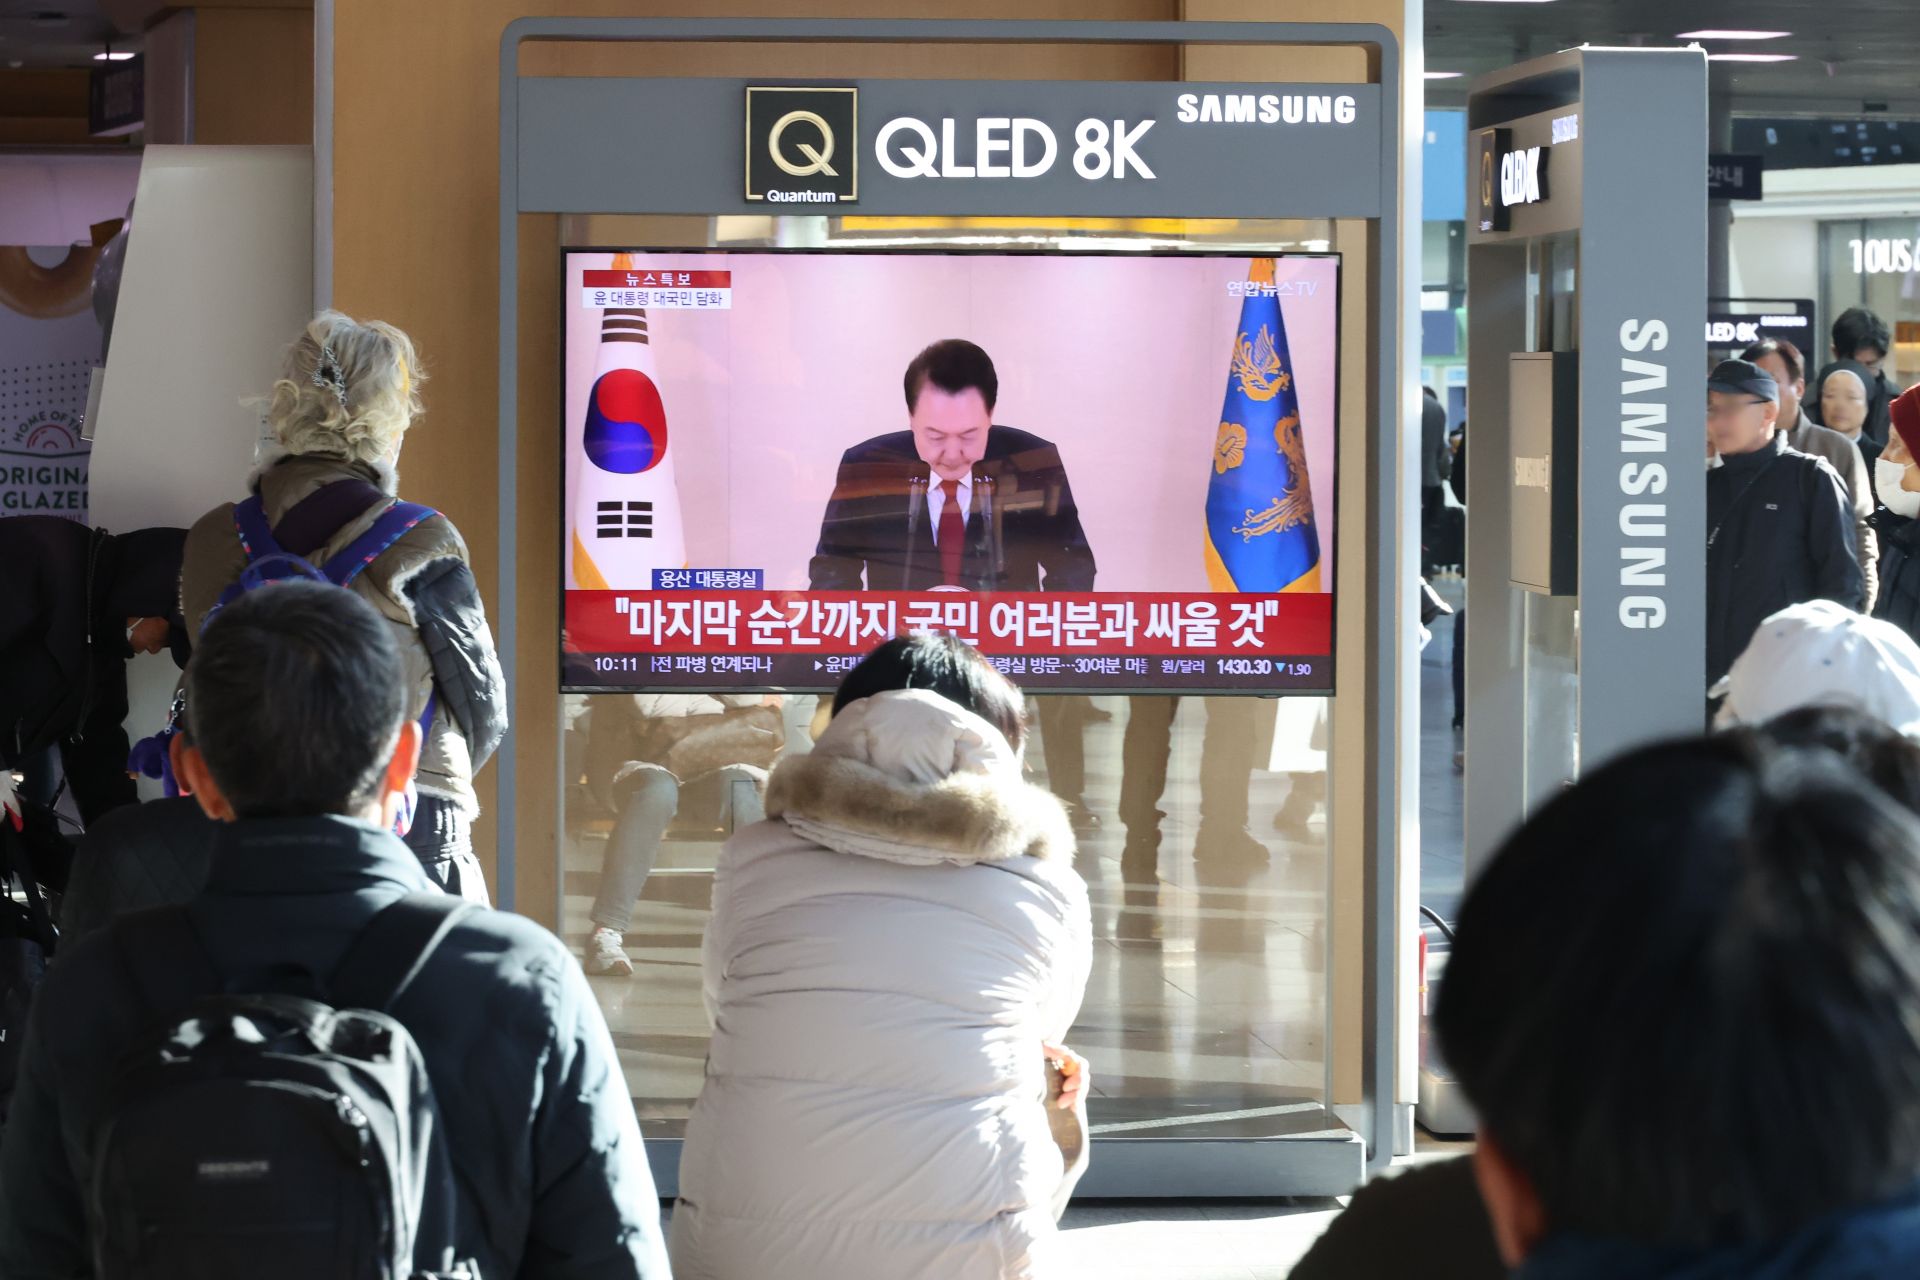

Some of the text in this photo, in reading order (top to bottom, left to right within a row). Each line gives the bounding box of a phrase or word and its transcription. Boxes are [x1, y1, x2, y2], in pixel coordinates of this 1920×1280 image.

[1177, 93, 1356, 123] SAMSUNG
[874, 117, 1157, 180] QLED 8K
[767, 189, 836, 203] Quantum
[625, 273, 691, 286] 뉴스특보
[1226, 281, 1318, 297] 연합뉴스TV
[594, 291, 722, 306] 윤 대통령 대국민 담화
[13, 410, 47, 442] HOME
[50, 411, 68, 421] OF
[1619, 319, 1669, 628] SAMSUNG
[659, 570, 757, 589] 용산 대통령실
[615, 597, 1279, 648] "마지막 순간까지 국민 여러분과 싸울 것"
[594, 657, 637, 671] 10:11
[651, 656, 773, 673] 전 파병 연계되나
[1161, 658, 1311, 676] 원/달러 1430.30 1.90
